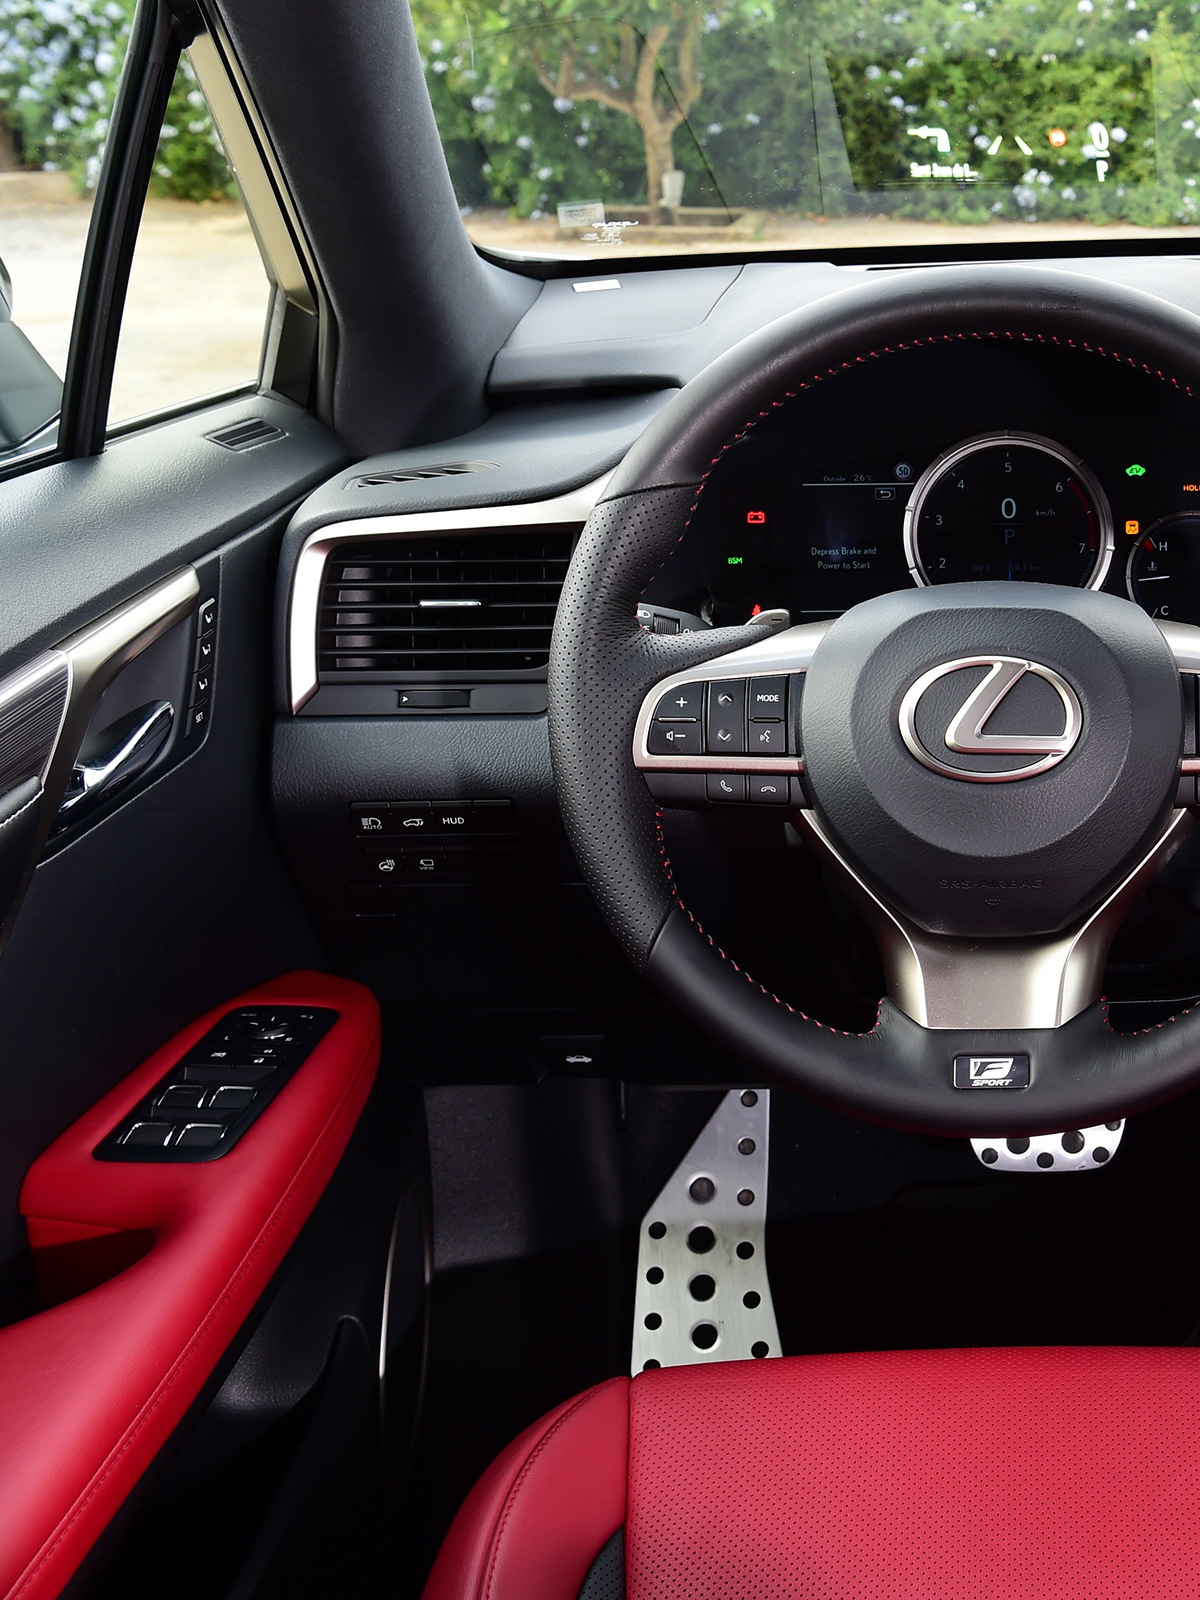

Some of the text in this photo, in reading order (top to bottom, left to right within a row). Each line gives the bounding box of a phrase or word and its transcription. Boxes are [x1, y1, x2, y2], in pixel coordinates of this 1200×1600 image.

[898, 467, 909, 478] 50
[1004, 462, 1013, 473] 5
[957, 479, 965, 490] 4
[1055, 482, 1064, 493] 6
[1001, 497, 1017, 519] 0
[1035, 509, 1056, 518] km/h
[935, 514, 943, 526] 3
[1004, 529, 1016, 545] P
[811, 546, 877, 557] Depress Brake and
[1078, 543, 1086, 553] 7
[1159, 541, 1168, 552] H
[727, 557, 743, 565] BSM
[817, 561, 840, 570] Power
[852, 560, 871, 569] Start
[939, 557, 947, 569] 2
[1160, 605, 1169, 616] C
[756, 694, 780, 702] MODE
[442, 817, 465, 825] HUD
[971, 1079, 1013, 1087] SPORT
